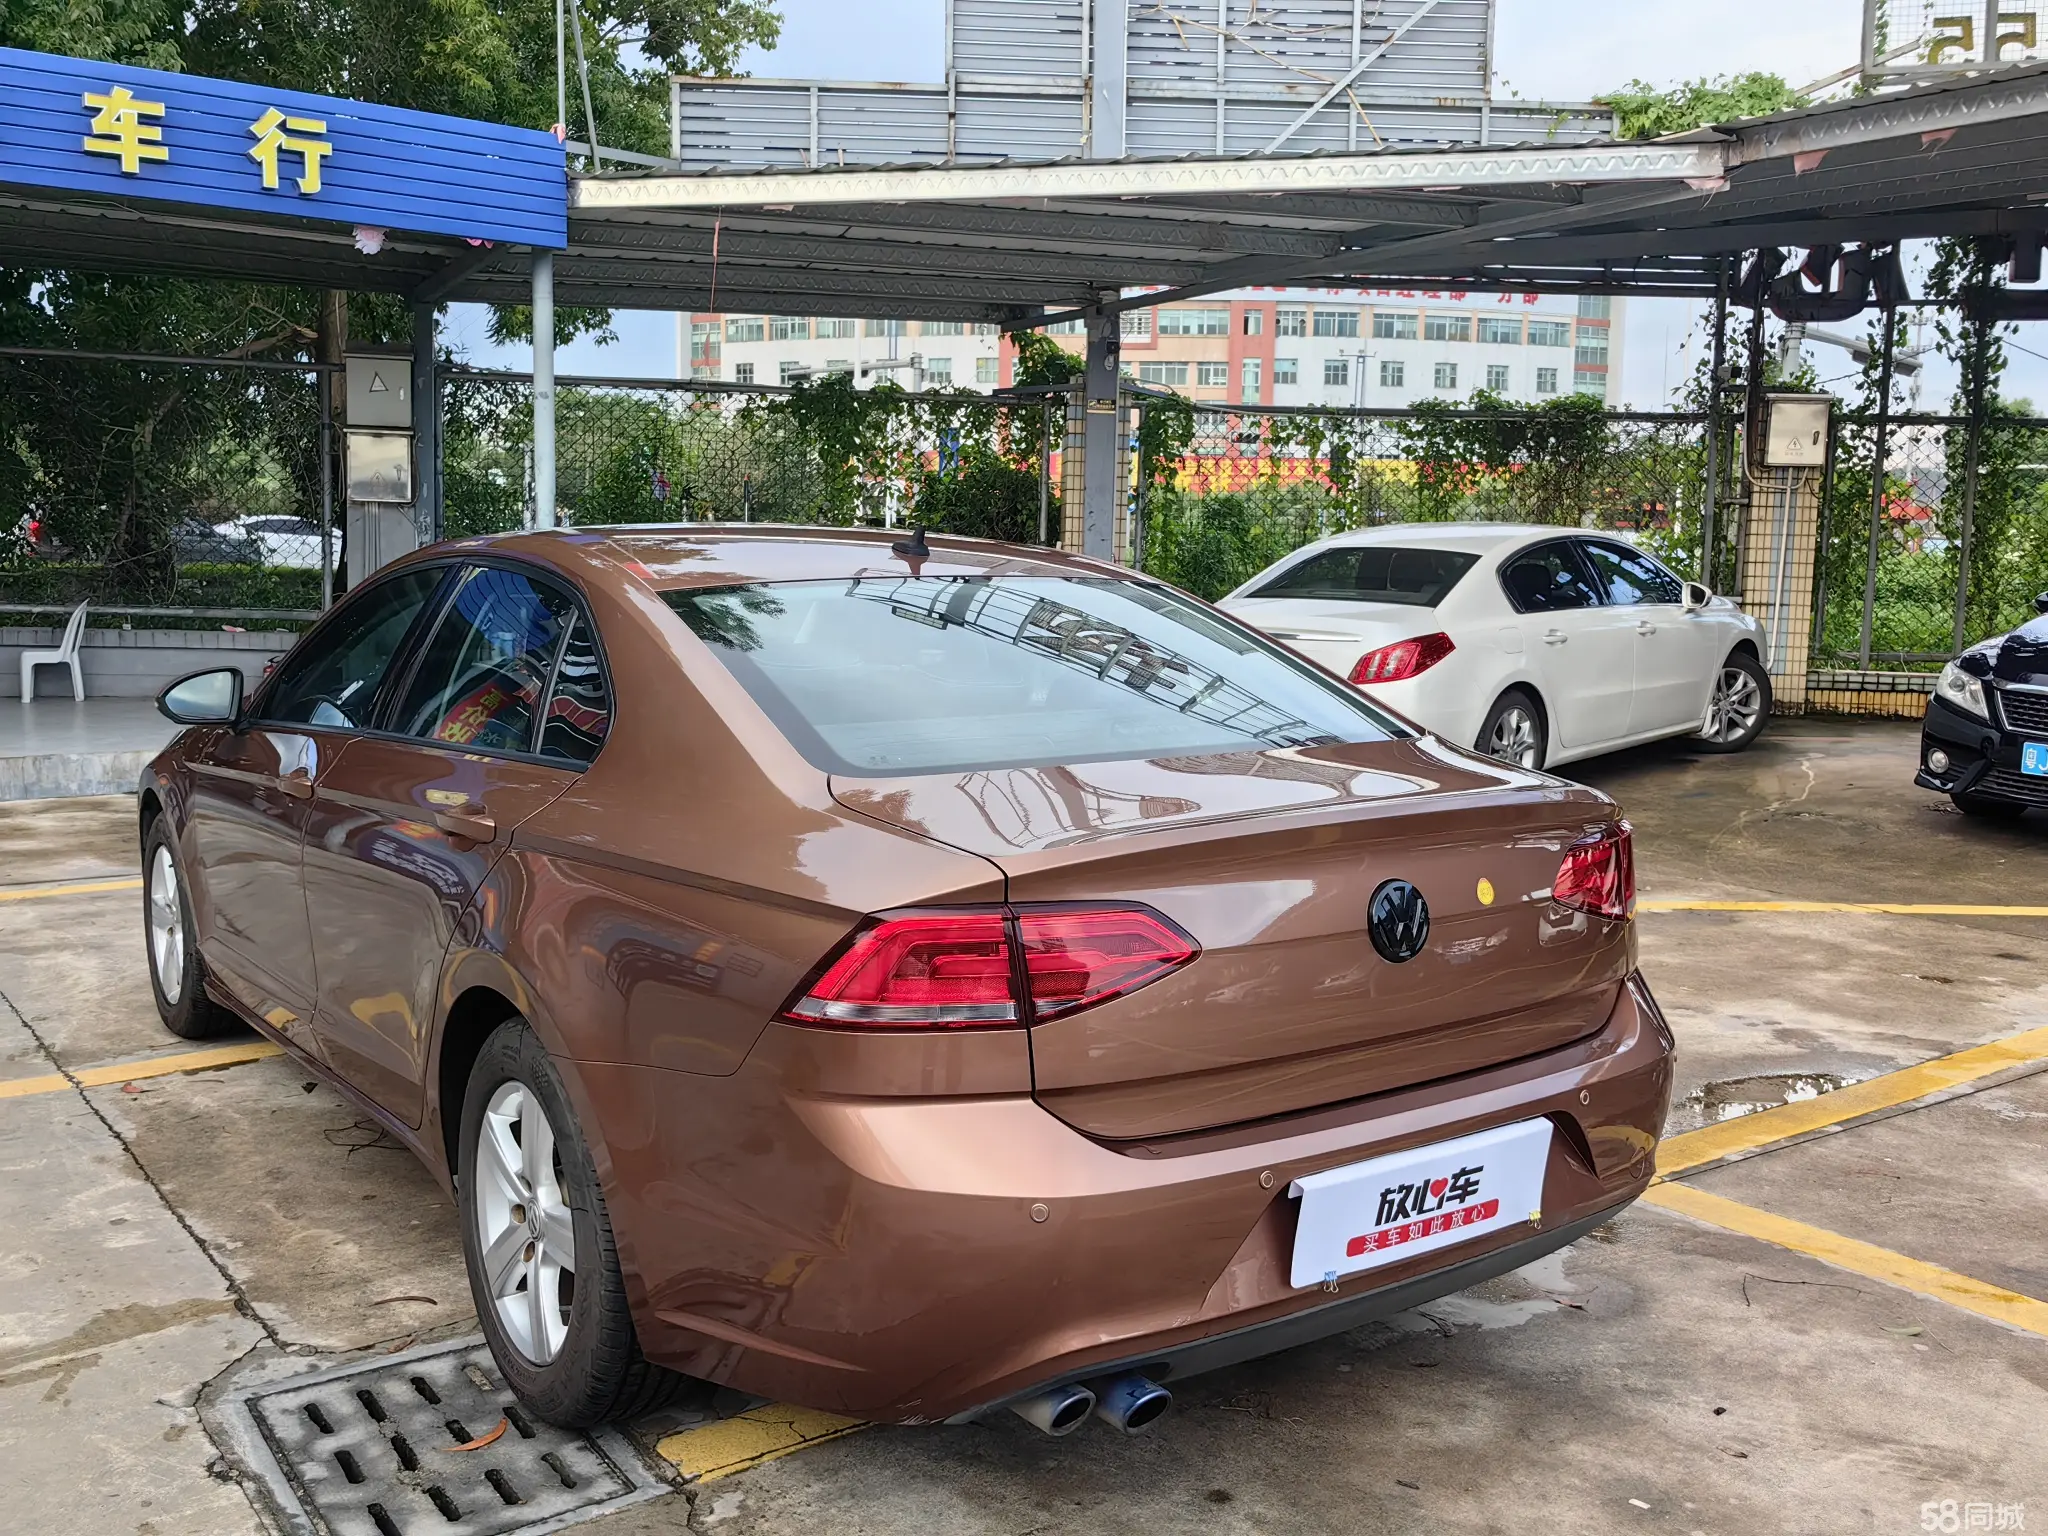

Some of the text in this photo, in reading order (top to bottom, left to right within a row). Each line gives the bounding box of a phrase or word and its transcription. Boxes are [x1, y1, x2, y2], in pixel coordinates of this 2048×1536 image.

[82, 85, 333, 196] 车行
[1375, 1165, 1484, 1227] 放心车
[1363, 1204, 1486, 1253] 买车如此放心
